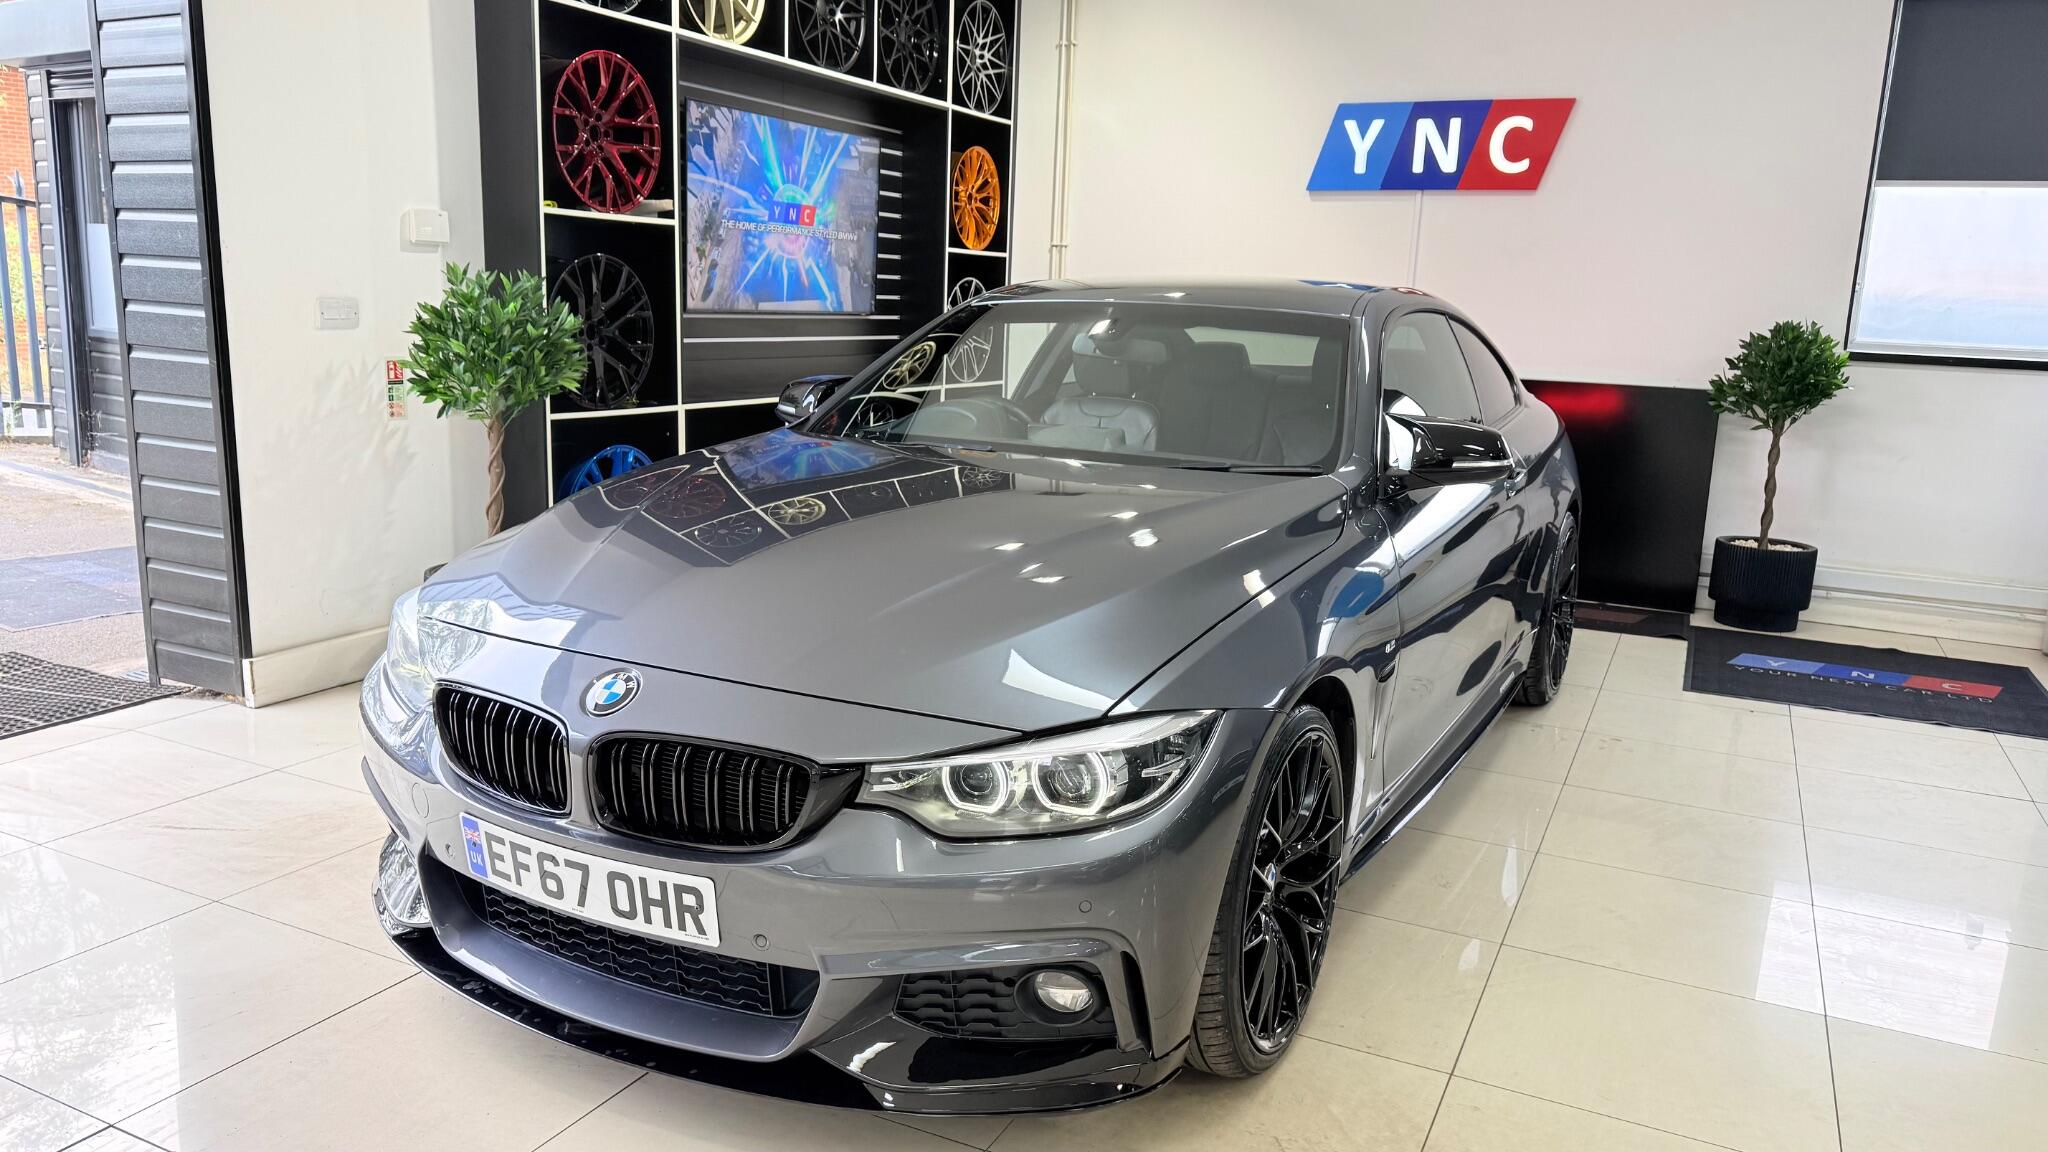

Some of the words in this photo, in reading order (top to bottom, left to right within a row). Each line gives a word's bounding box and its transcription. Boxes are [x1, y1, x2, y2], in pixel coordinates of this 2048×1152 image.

[1343, 115, 1534, 174] YNC
[721, 219, 735, 229] THE
[735, 220, 757, 231] HOME
[757, 222, 767, 231] OF
[767, 224, 814, 236] PERFORMANCE
[814, 229, 838, 239] STYLED
[774, 205, 811, 222] YNC
[1734, 665, 1797, 677] YOUR
[1810, 675, 1872, 687] NEXT
[1885, 685, 1933, 695] CAR
[1946, 692, 1993, 703] LTD
[1765, 659, 1962, 690] YNC
[470, 850, 484, 866] UK
[484, 830, 590, 908] EF67
